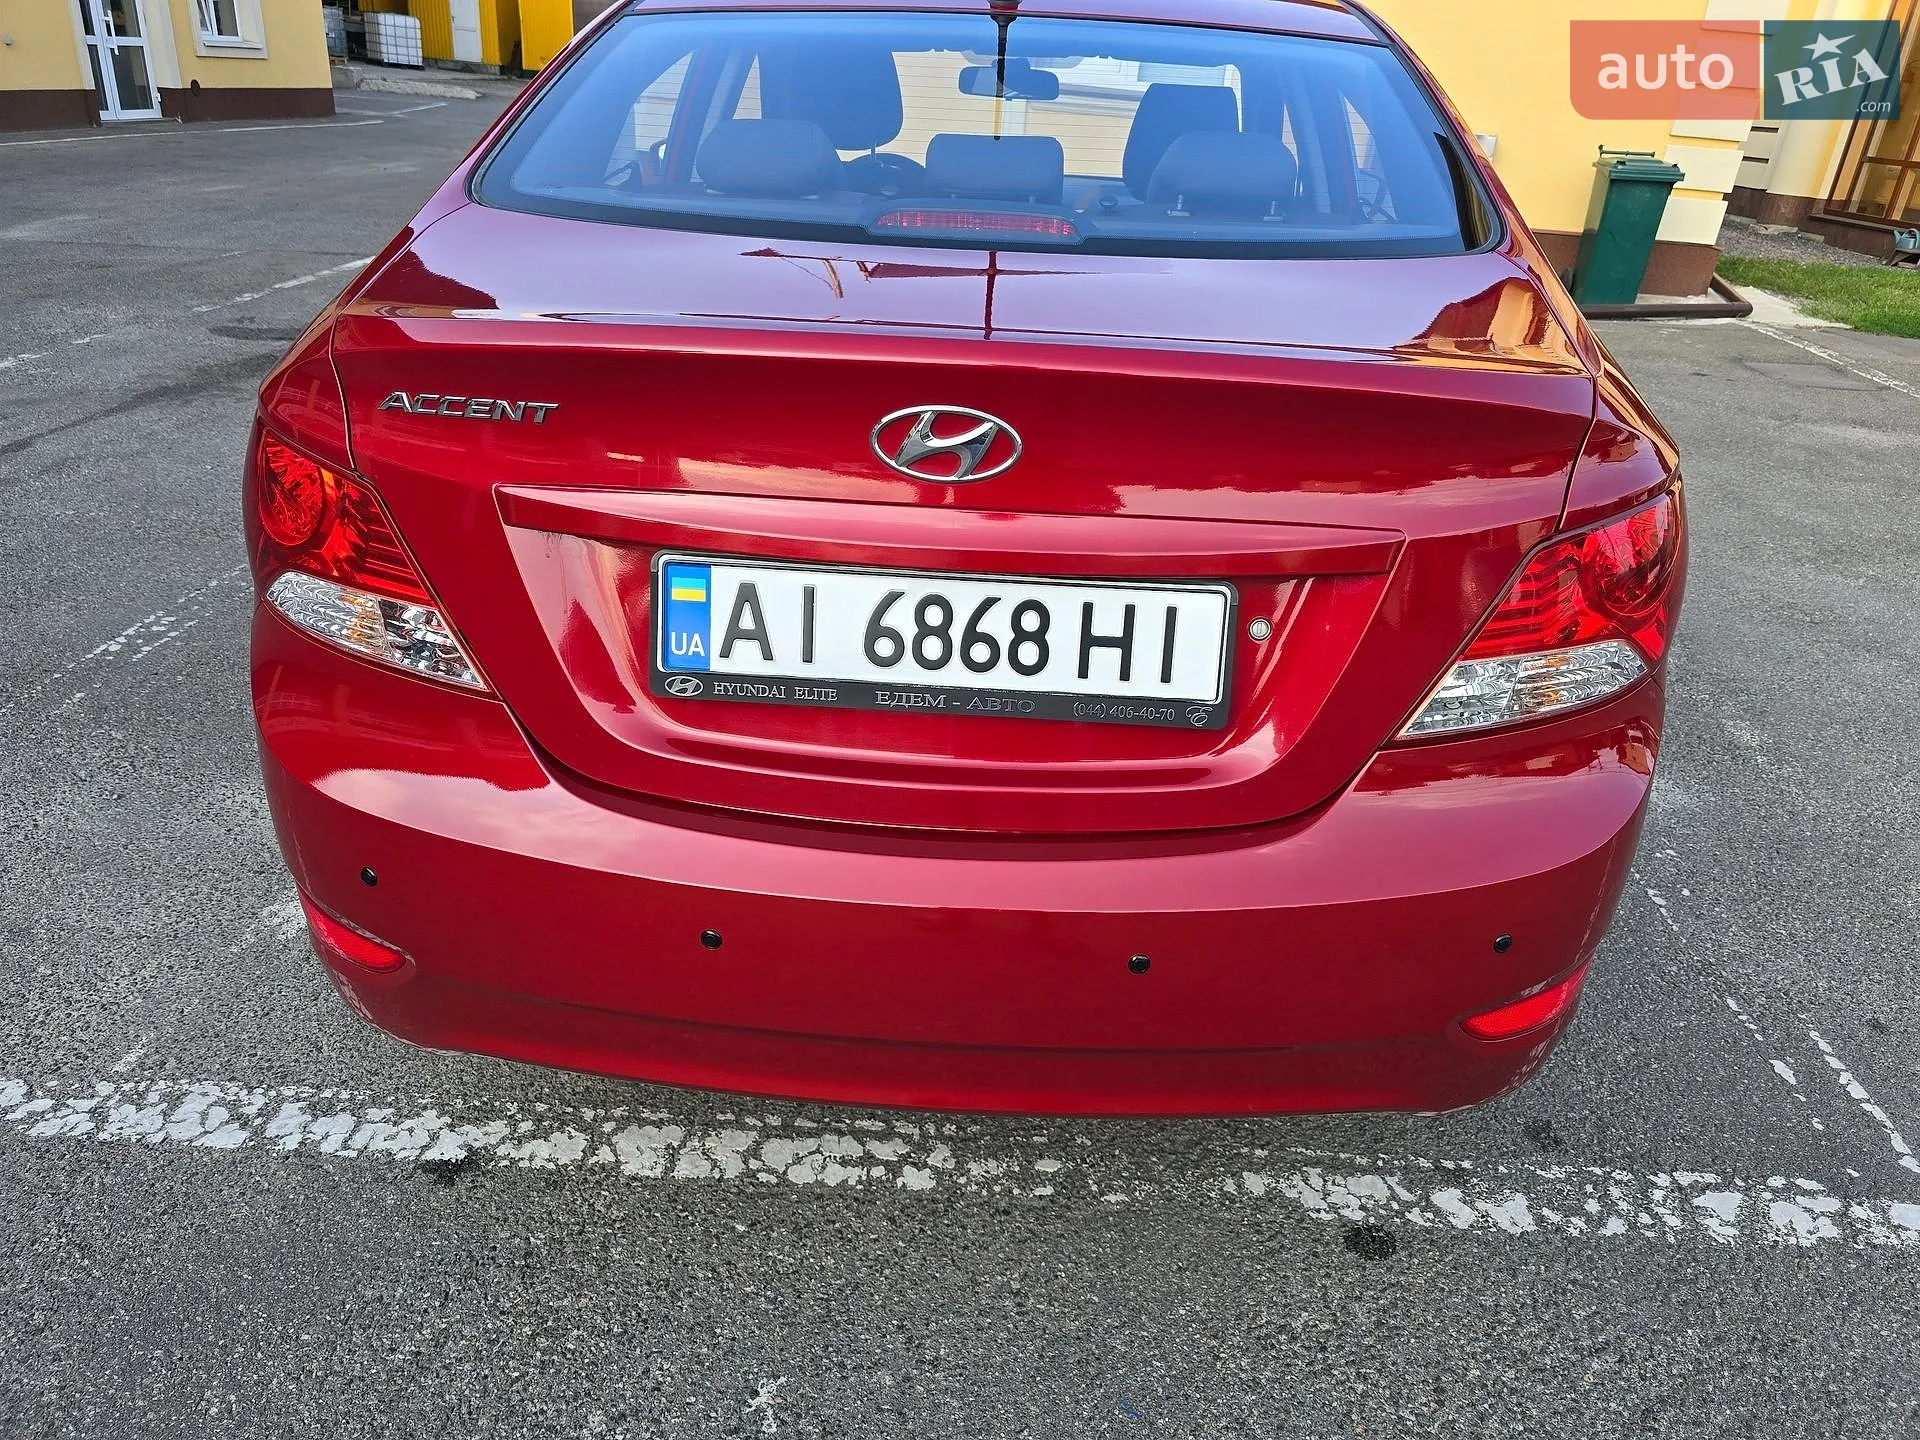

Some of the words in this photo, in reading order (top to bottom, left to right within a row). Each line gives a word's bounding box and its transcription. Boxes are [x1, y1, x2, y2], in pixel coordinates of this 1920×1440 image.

[378, 391, 561, 424] ACCENT
[670, 631, 706, 657] UA
[718, 581, 817, 664] AI
[863, 589, 1050, 676] 6868
[1077, 601, 1178, 684] HI
[713, 682, 786, 699] HYUNDAI
[793, 687, 838, 701] ELITE
[875, 691, 947, 708] ЕДЕМ
[966, 696, 1036, 713] АВТО
[1073, 701, 1106, 718] (044)
[1109, 705, 1175, 721] 406-40-70
